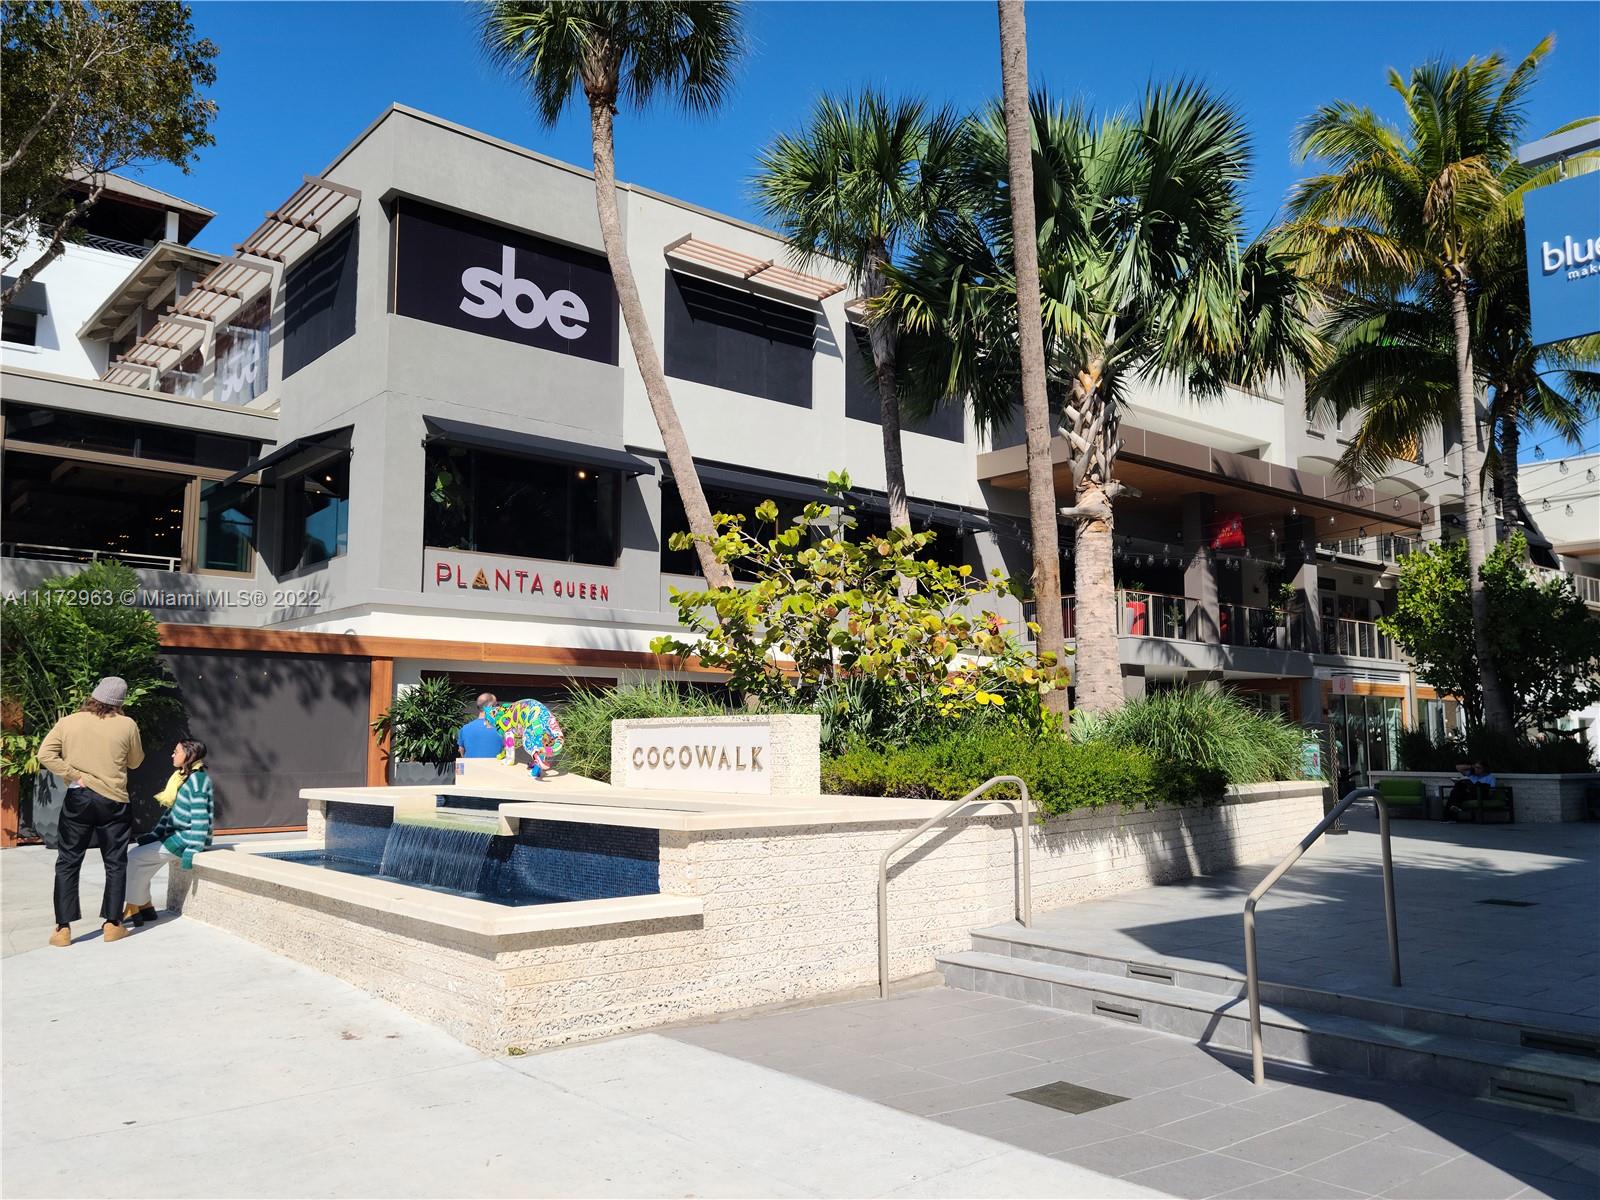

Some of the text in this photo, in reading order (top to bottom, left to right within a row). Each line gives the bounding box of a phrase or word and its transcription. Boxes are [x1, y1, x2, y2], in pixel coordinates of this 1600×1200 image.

[1542, 234, 1600, 271] blu
[1567, 263, 1600, 280] mak
[459, 244, 590, 340] sbe
[435, 562, 609, 602] PLANTA QUEEN
[632, 745, 764, 772] COCOWALK
